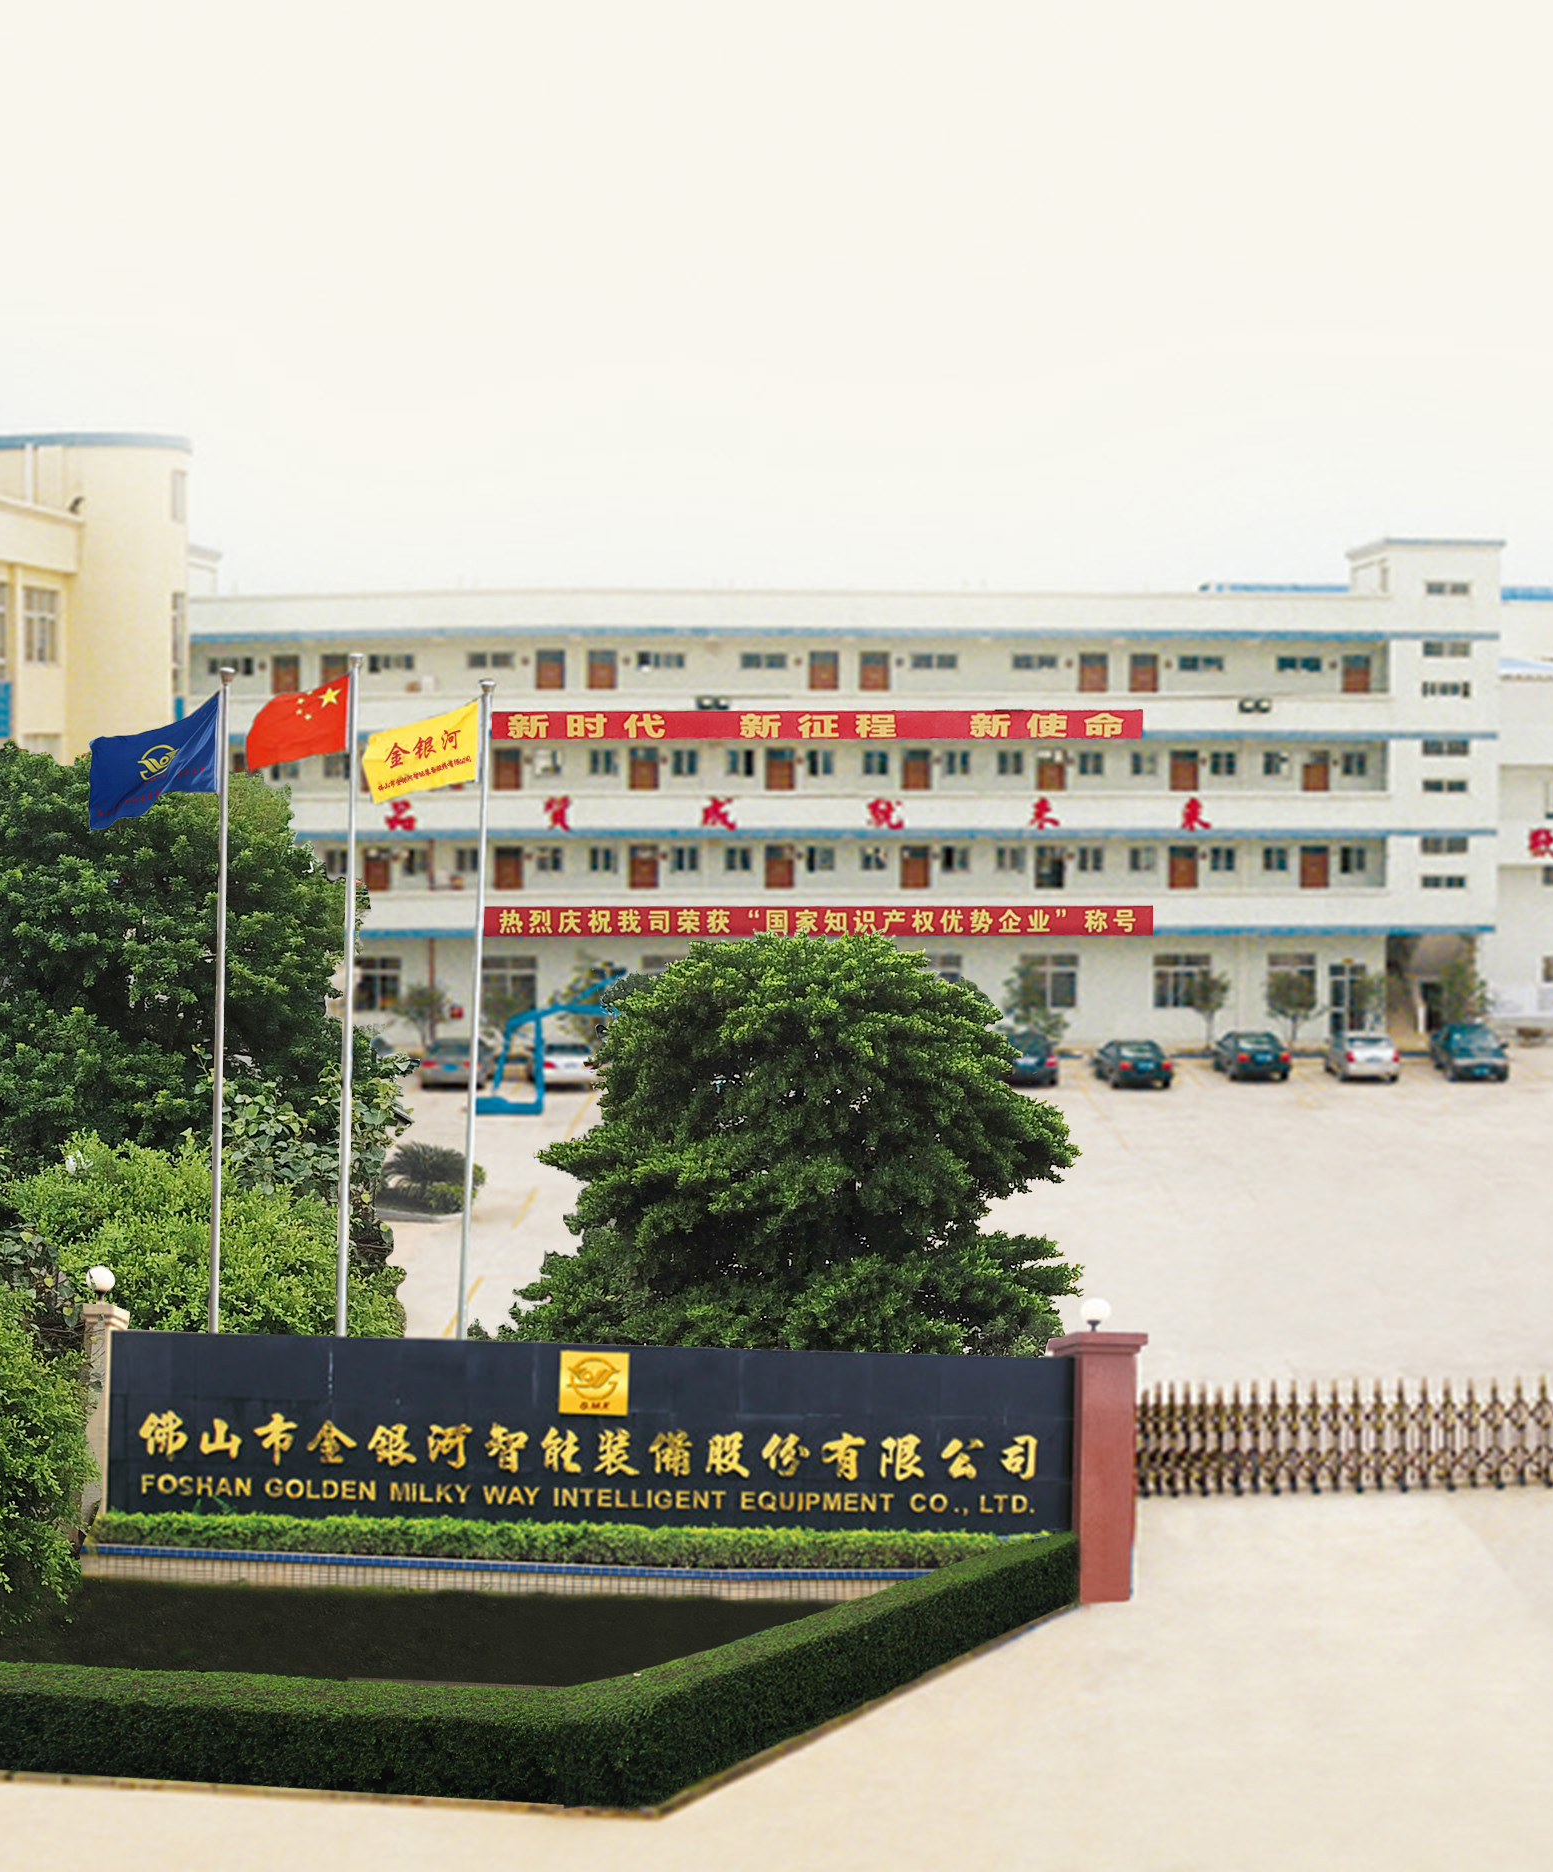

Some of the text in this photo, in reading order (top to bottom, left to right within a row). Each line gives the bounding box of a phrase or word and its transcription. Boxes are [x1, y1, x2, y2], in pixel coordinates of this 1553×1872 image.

[507, 712, 1125, 739] 新时代 新征程 新使命
[384, 729, 461, 769] 金银河
[140, 1473, 252, 1499] FOSHAN
[264, 1478, 377, 1502] GOLDEN
[482, 1485, 541, 1506] WAY
[553, 1487, 727, 1510] INTELLIGENT
[740, 1490, 895, 1512] EQUIPMENT
[909, 1493, 970, 1515] CO.,
[980, 1494, 1036, 1514] LTD.
